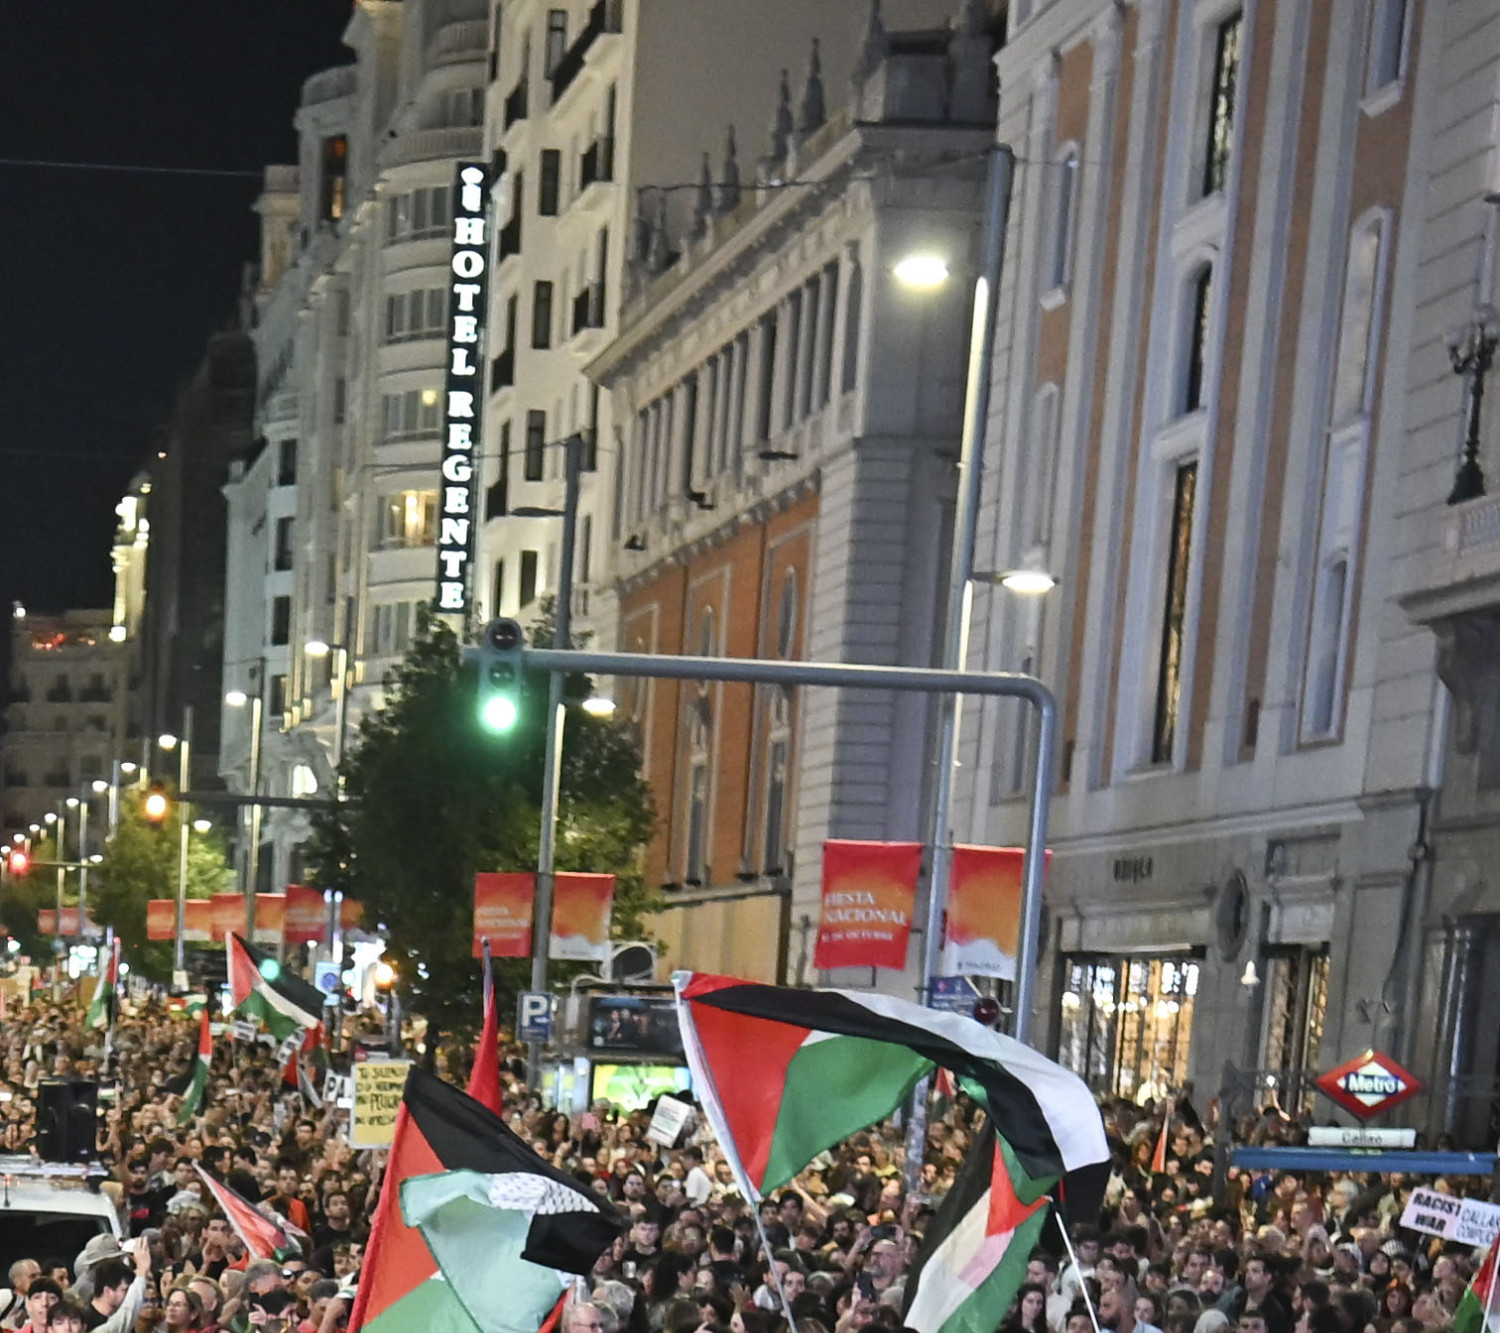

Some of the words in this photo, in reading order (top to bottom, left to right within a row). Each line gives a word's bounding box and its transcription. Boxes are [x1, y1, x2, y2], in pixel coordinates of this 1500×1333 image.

[451, 217, 486, 376] HOTEL
[438, 391, 475, 609] REGENTE
[825, 908, 907, 926] NACIONAL
[520, 994, 548, 1027] P
[1348, 1073, 1396, 1093] Metro
